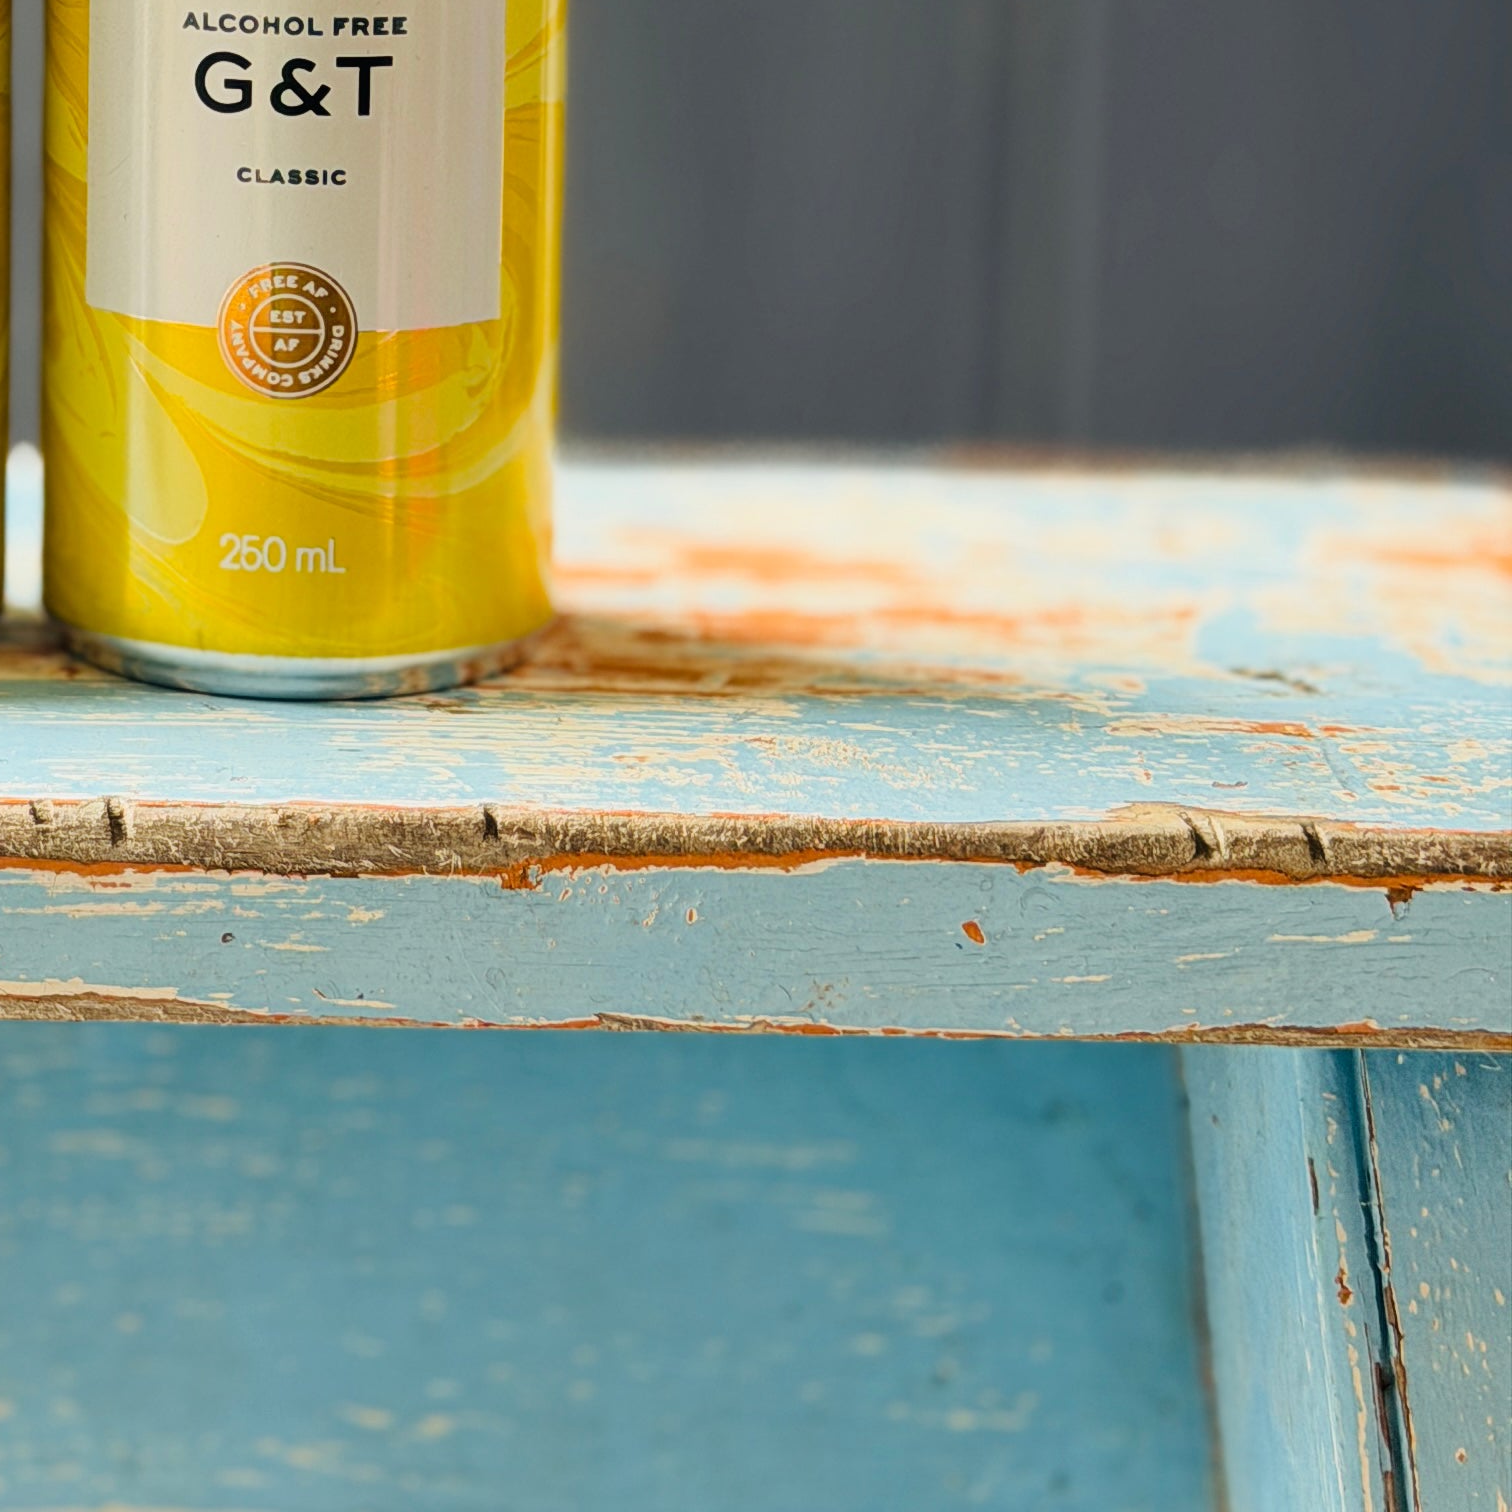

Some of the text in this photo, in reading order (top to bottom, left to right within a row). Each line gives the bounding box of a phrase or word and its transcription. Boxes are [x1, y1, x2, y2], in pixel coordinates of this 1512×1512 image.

[181, 11, 409, 36] ALCOHOL FREE
[193, 50, 395, 117] G&T
[236, 167, 348, 186] CLASSIC
[247, 275, 329, 299] FREE AF
[269, 310, 307, 324] EST
[229, 319, 345, 387] DRINKS COMPANY
[273, 338, 300, 352] AF
[218, 532, 347, 574] 250 mL
